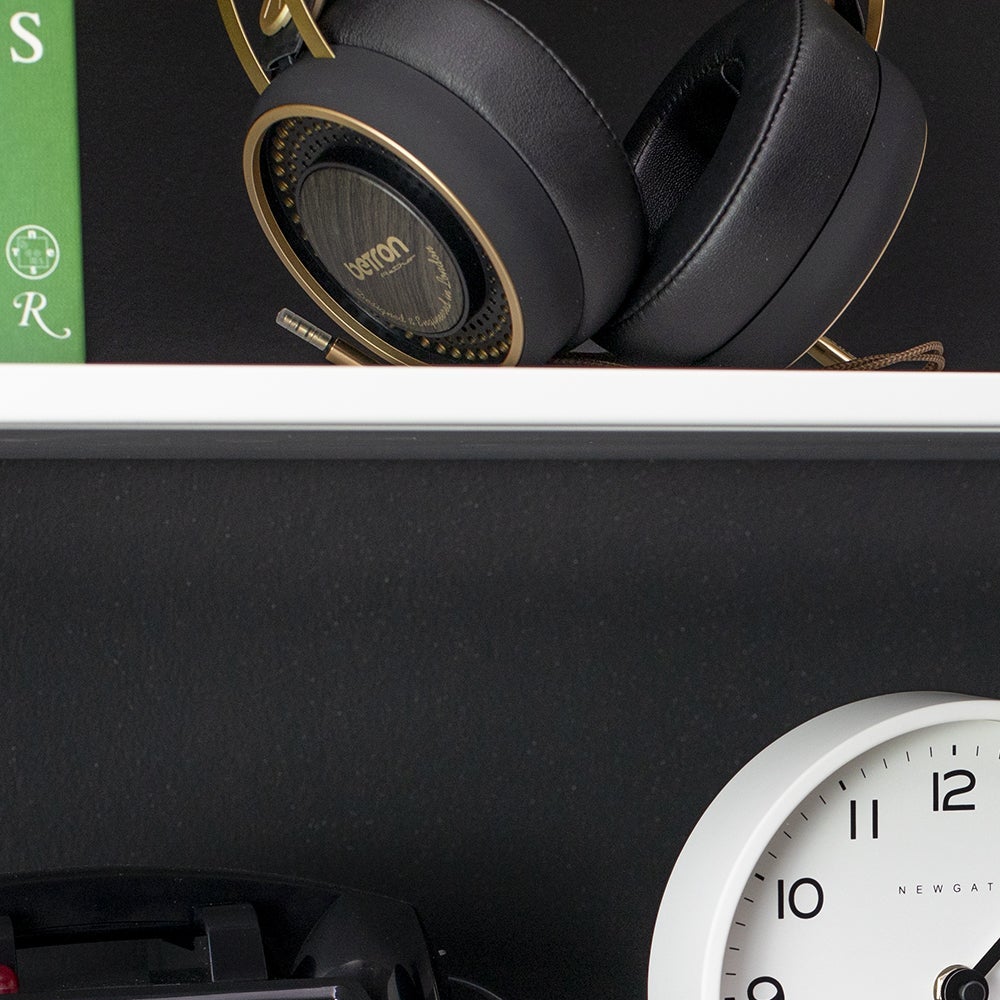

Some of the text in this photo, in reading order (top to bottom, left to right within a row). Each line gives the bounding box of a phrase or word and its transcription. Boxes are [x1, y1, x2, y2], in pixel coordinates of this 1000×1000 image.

[343, 235, 410, 281] betron
[932, 769, 977, 812] 12
[849, 799, 879, 840] 11
[777, 877, 824, 920] 10
